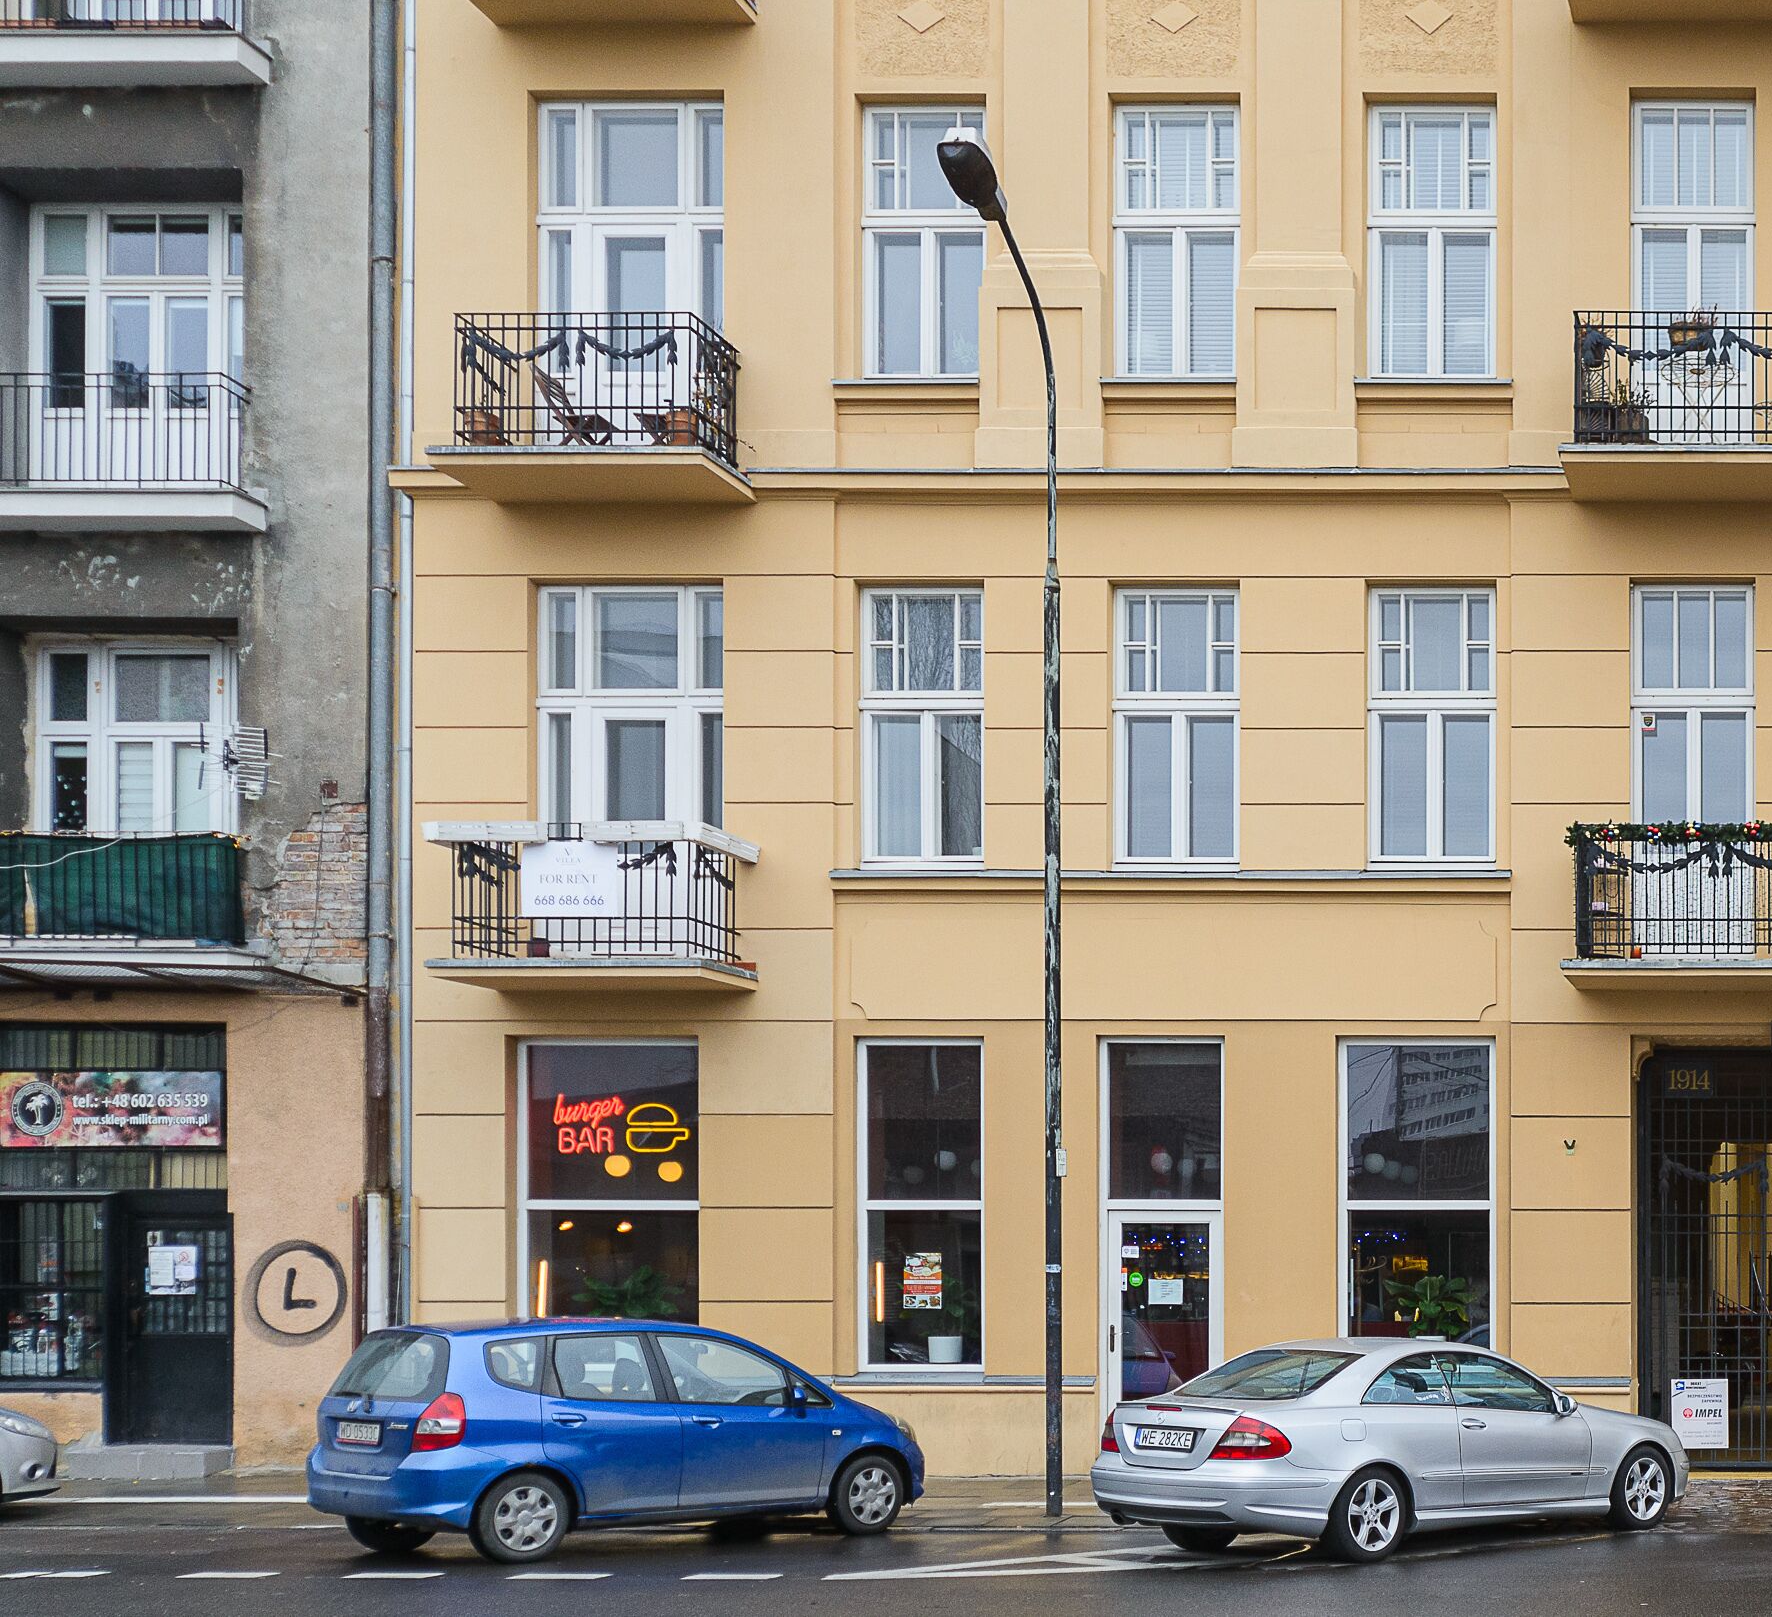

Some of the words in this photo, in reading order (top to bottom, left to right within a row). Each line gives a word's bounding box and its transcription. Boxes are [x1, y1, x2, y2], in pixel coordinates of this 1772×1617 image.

[540, 874, 563, 884] FOR
[567, 874, 597, 884] RENT
[534, 894, 555, 906] 668
[559, 894, 580, 906] 686
[583, 894, 604, 906] 666
[1668, 1069, 1711, 1090] 1914
[72, 1093, 99, 1108] tel.:
[101, 1093, 129, 1108] +48
[130, 1093, 154, 1108] 602
[157, 1093, 181, 1108] 635
[184, 1093, 208, 1108] 539
[553, 1093, 625, 1129] burger
[72, 1113, 208, 1127] www.sklep-militarny.com.pl
[558, 1126, 615, 1154] BAR
[1695, 1408, 1723, 1418] IMPEL
[1141, 1429, 1158, 1445] WE
[1158, 1431, 1193, 1448] 282KE
